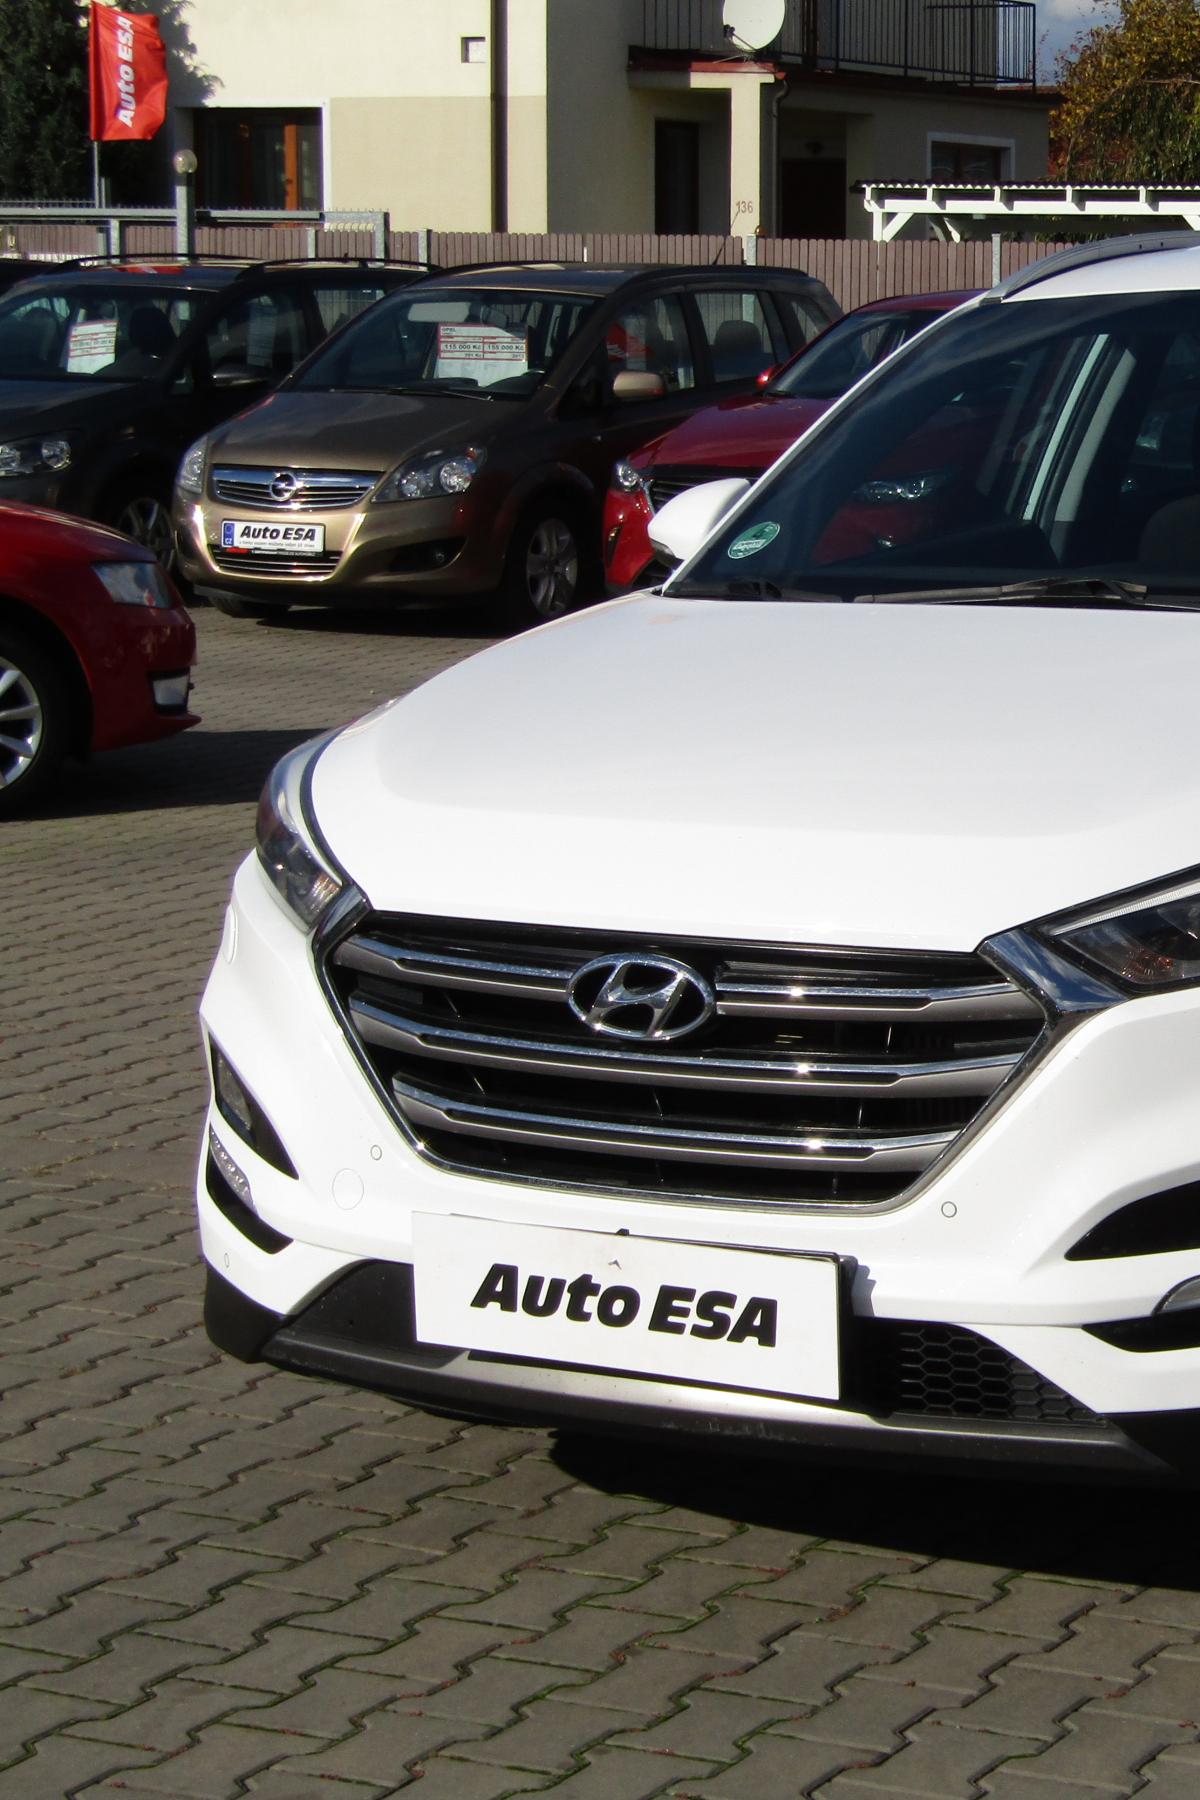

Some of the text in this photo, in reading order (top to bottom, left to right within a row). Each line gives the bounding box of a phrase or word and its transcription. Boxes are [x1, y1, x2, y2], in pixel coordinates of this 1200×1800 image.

[116, 15, 136, 128] Auto ESA
[735, 200, 754, 214] 136
[225, 537, 233, 545] CZ
[240, 525, 316, 541] Auto ESA
[470, 1263, 778, 1348] Auto ESA
